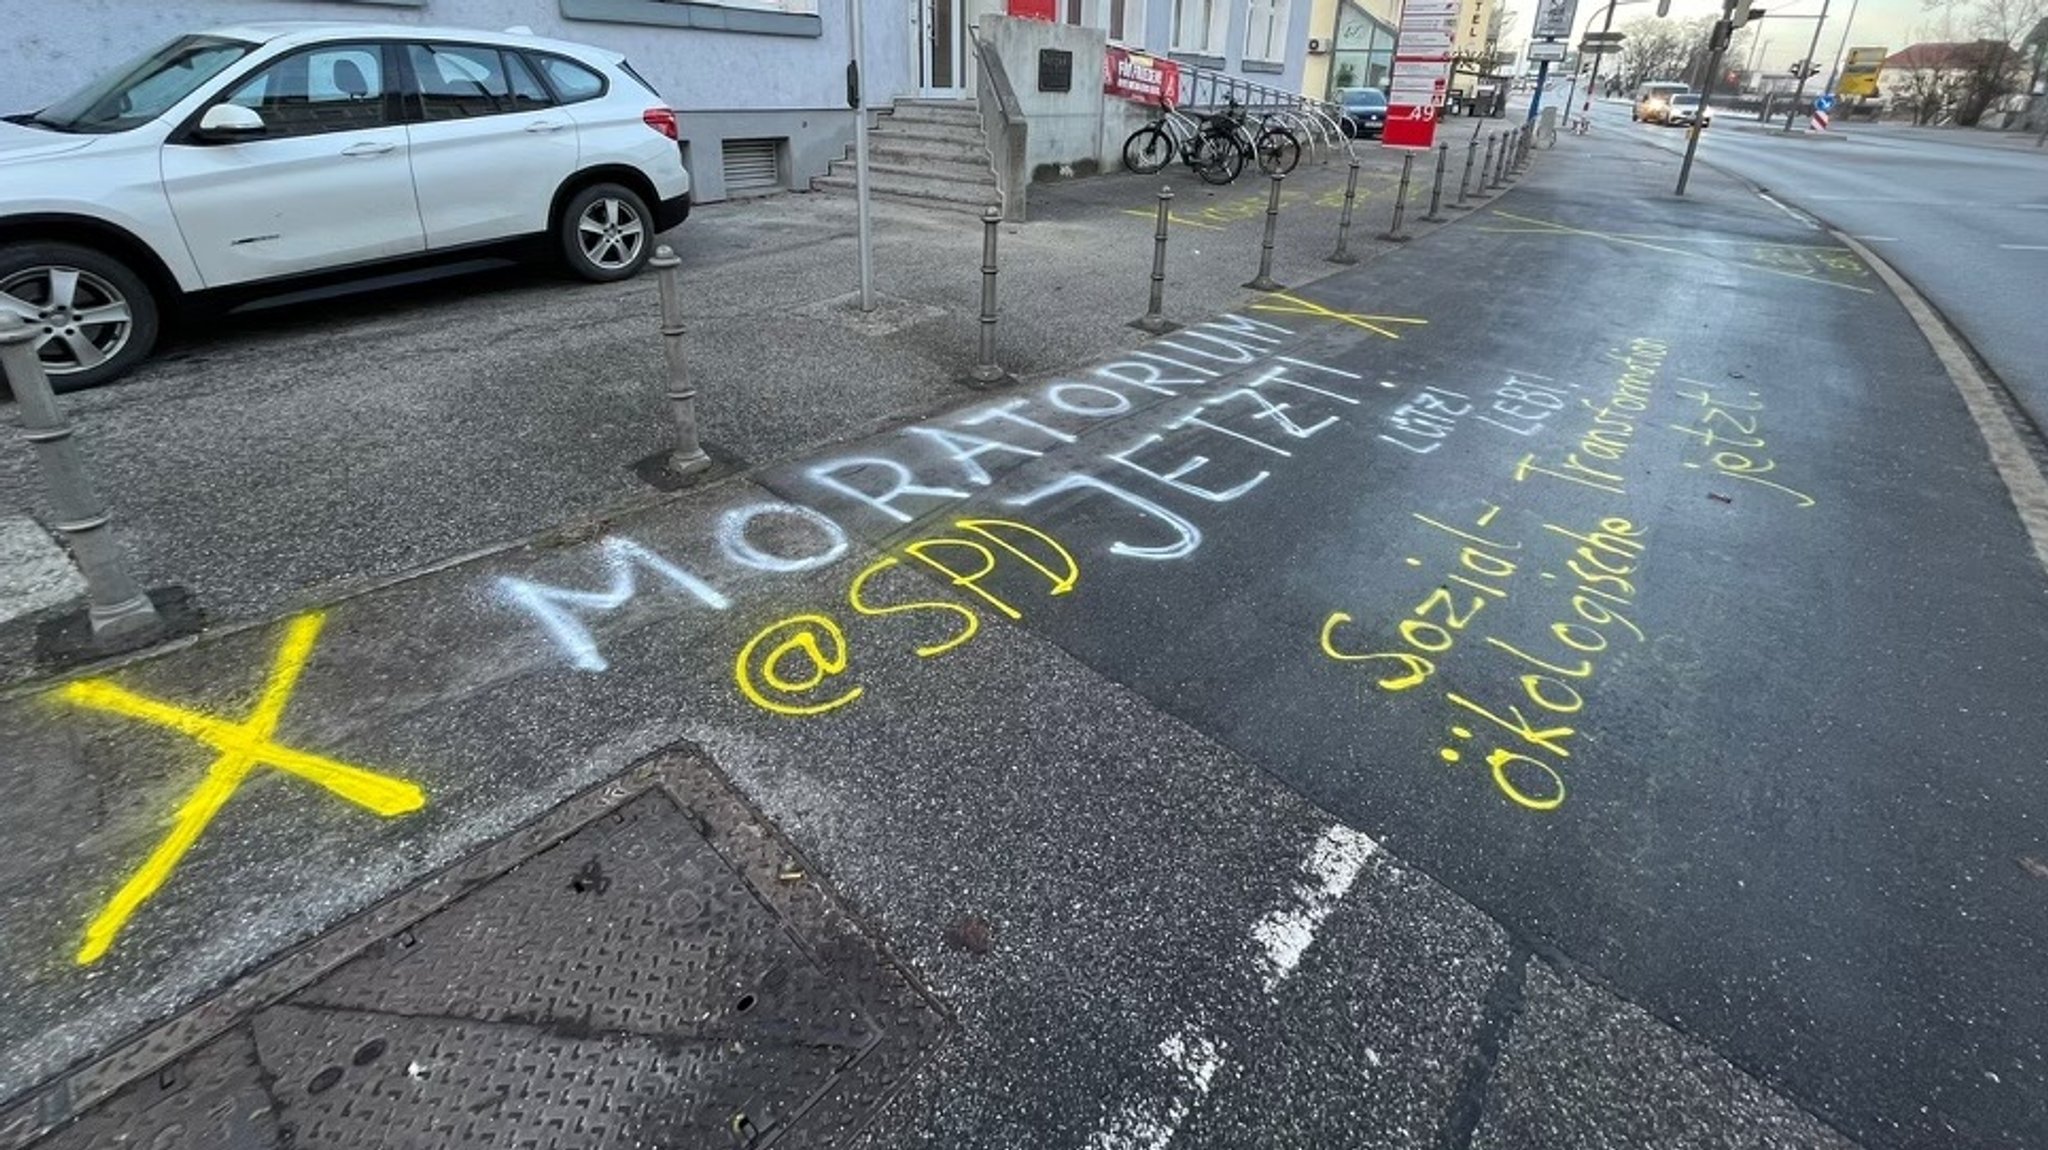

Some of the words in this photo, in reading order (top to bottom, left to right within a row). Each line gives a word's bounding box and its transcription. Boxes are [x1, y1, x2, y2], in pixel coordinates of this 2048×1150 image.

[1411, 105, 1434, 121] 49
[491, 314, 1296, 672] MORATORIUM
[1003, 355, 1396, 560] JETZT!
[1670, 377, 1816, 507] jetzt!
[735, 517, 1079, 715] @SPD
[1320, 505, 1523, 691] Sozial-
[1440, 516, 1649, 811] ökologische
